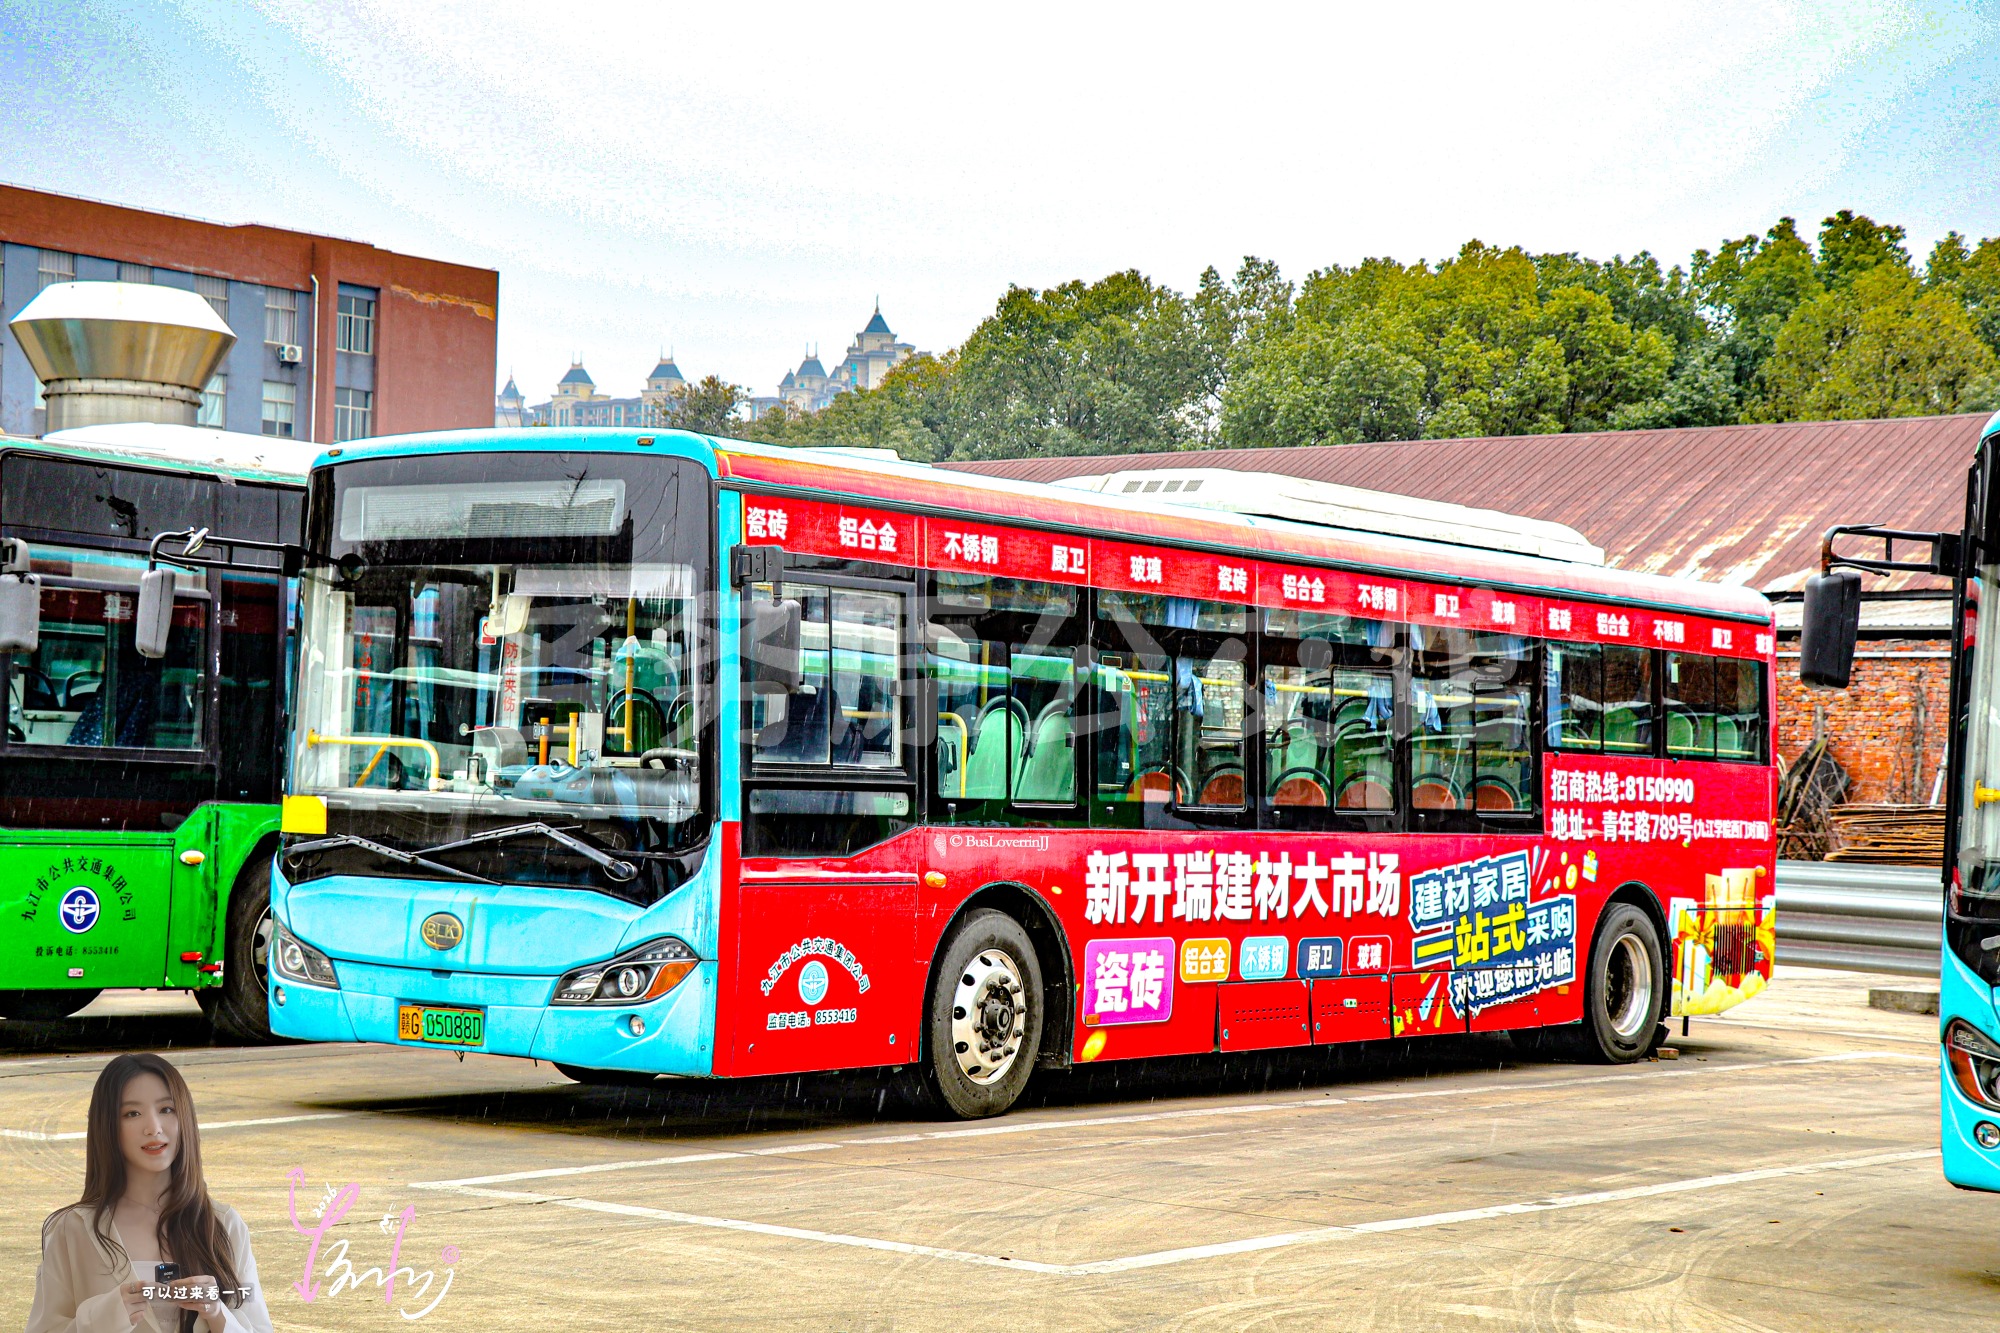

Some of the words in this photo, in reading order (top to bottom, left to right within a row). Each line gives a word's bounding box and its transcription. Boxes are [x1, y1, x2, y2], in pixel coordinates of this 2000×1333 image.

[746, 507, 788, 538] 瓷砖
[839, 516, 898, 553] 铝合金
[944, 532, 998, 564] 不锈钢
[1051, 545, 1086, 575] 厨卫
[1130, 556, 1162, 584] 玻璃
[1217, 566, 1248, 593] 瓷砖
[1282, 574, 1325, 603] 铝合金
[1357, 585, 1398, 612] 不锈钢
[1434, 594, 1460, 619] 厨卫
[1596, 612, 1630, 637] 铝合金
[503, 642, 518, 712] 防止夹伤
[21, 856, 136, 922] 九江市公共交通集团公司
[1084, 850, 1401, 925] 新开瑞建材大市场
[1415, 860, 1527, 922] 建材家居
[760, 937, 870, 996] 九江市公共交通集团公司
[1094, 952, 1164, 1014] 瓷砖
[1185, 945, 1227, 976] 铝合金
[1245, 944, 1284, 975] 不锈钢
[1306, 944, 1333, 972] 厨卫
[1357, 943, 1383, 970] 玻璃
[1454, 947, 1571, 1004] 欢迎您的光临
